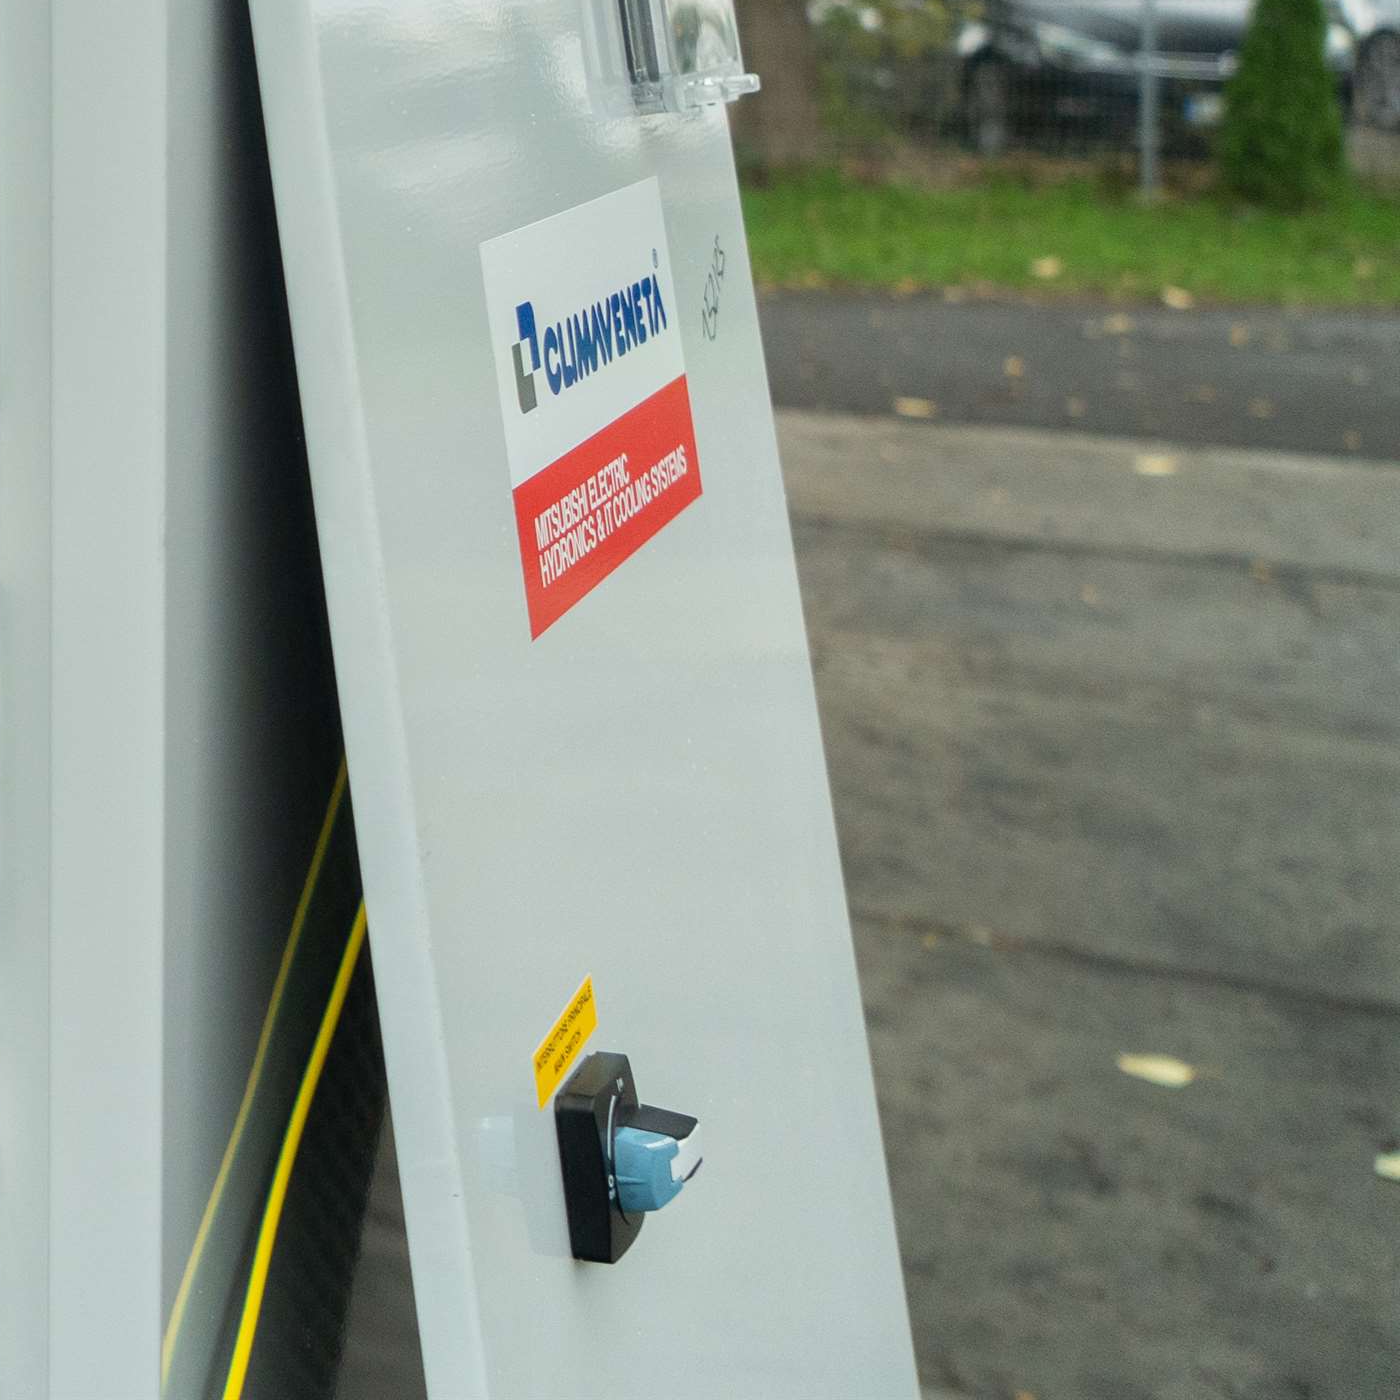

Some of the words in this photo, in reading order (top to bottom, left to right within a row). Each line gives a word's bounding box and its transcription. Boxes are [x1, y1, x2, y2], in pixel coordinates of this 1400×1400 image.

[544, 273, 667, 396] CLIMAVENETA
[534, 483, 588, 551] MITSUBISHI
[587, 453, 630, 513] ELECTRIC
[539, 517, 597, 588] HYDRONICS
[596, 511, 605, 541] &
[604, 503, 614, 536] IT
[612, 471, 652, 529] COOLING
[650, 444, 688, 498] SYSTEMS
